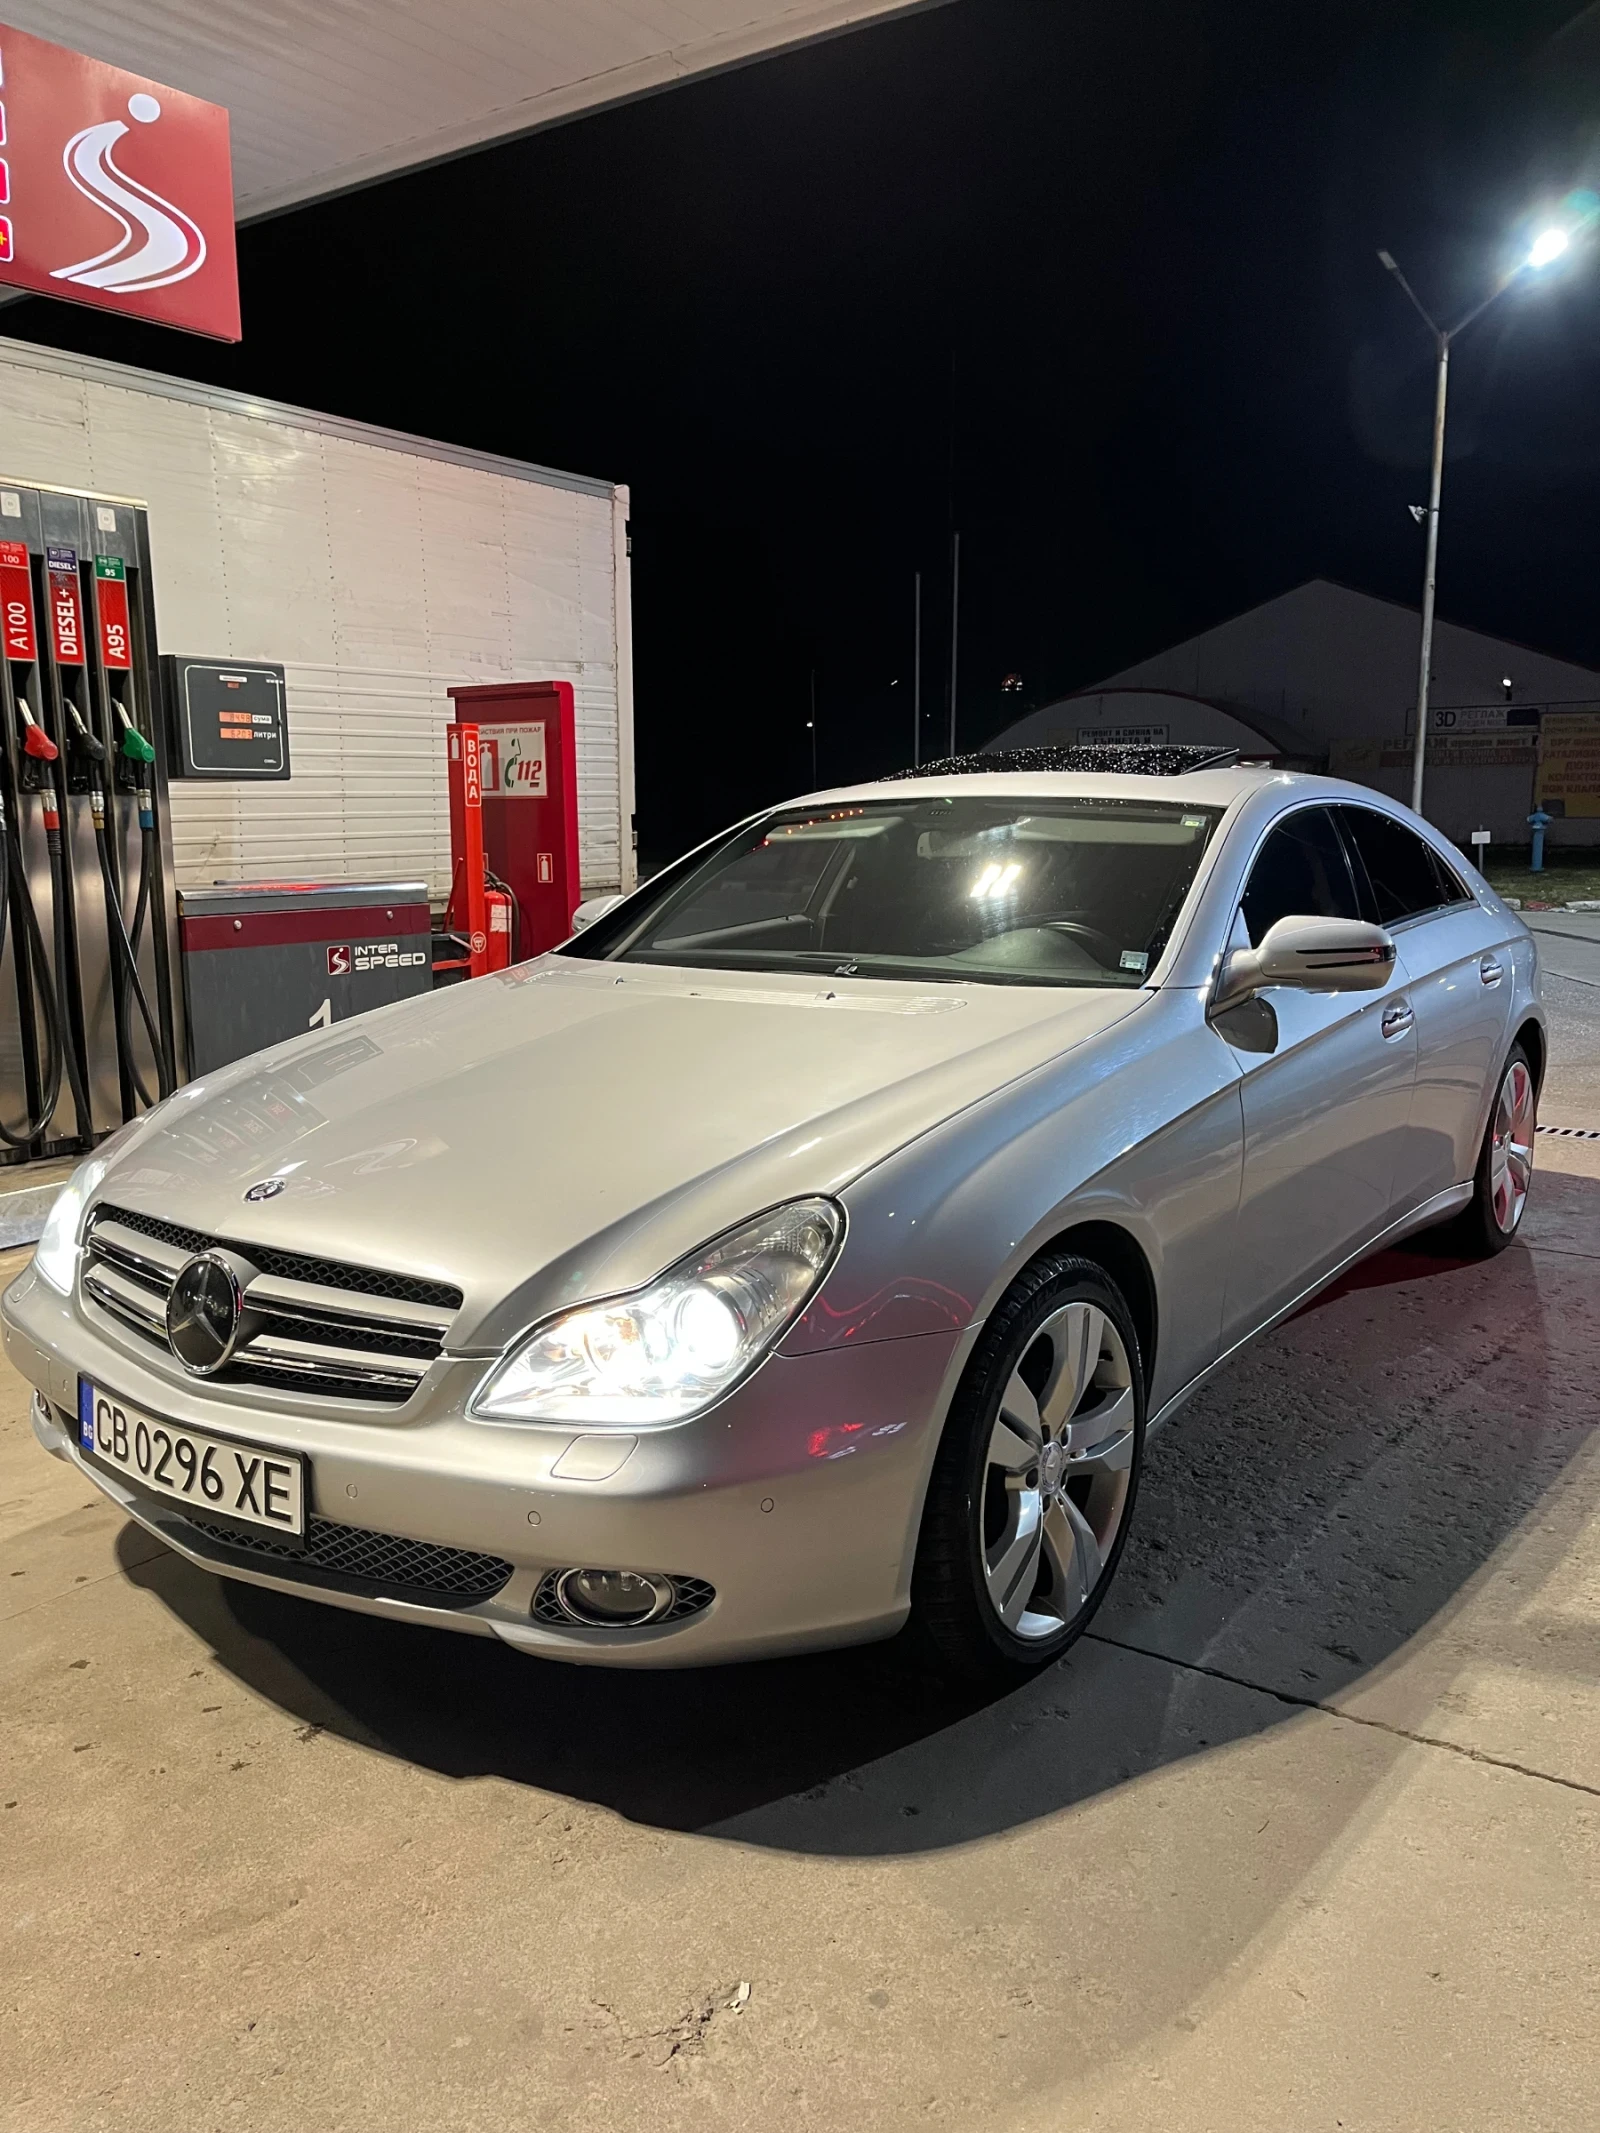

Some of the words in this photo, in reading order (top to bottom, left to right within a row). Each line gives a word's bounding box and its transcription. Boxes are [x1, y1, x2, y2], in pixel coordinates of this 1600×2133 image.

[2, 554, 20, 565] 100
[104, 568, 116, 577] 95
[7, 602, 29, 651] A100
[106, 623, 126, 660] A95
[253, 716, 270, 724] сума
[1435, 711, 1457, 728] 3D
[1460, 709, 1506, 719] РЕГЛАЖ
[253, 731, 277, 740] литри
[1383, 737, 1448, 750] РЕГАЖ
[467, 739, 478, 799] ВОДА
[517, 760, 542, 781] 112
[354, 943, 398, 956] INTER
[354, 952, 426, 971] SPEED
[82, 1420, 94, 1440] BG
[135, 1421, 224, 1500] 0296
[234, 1452, 293, 1523] XE
